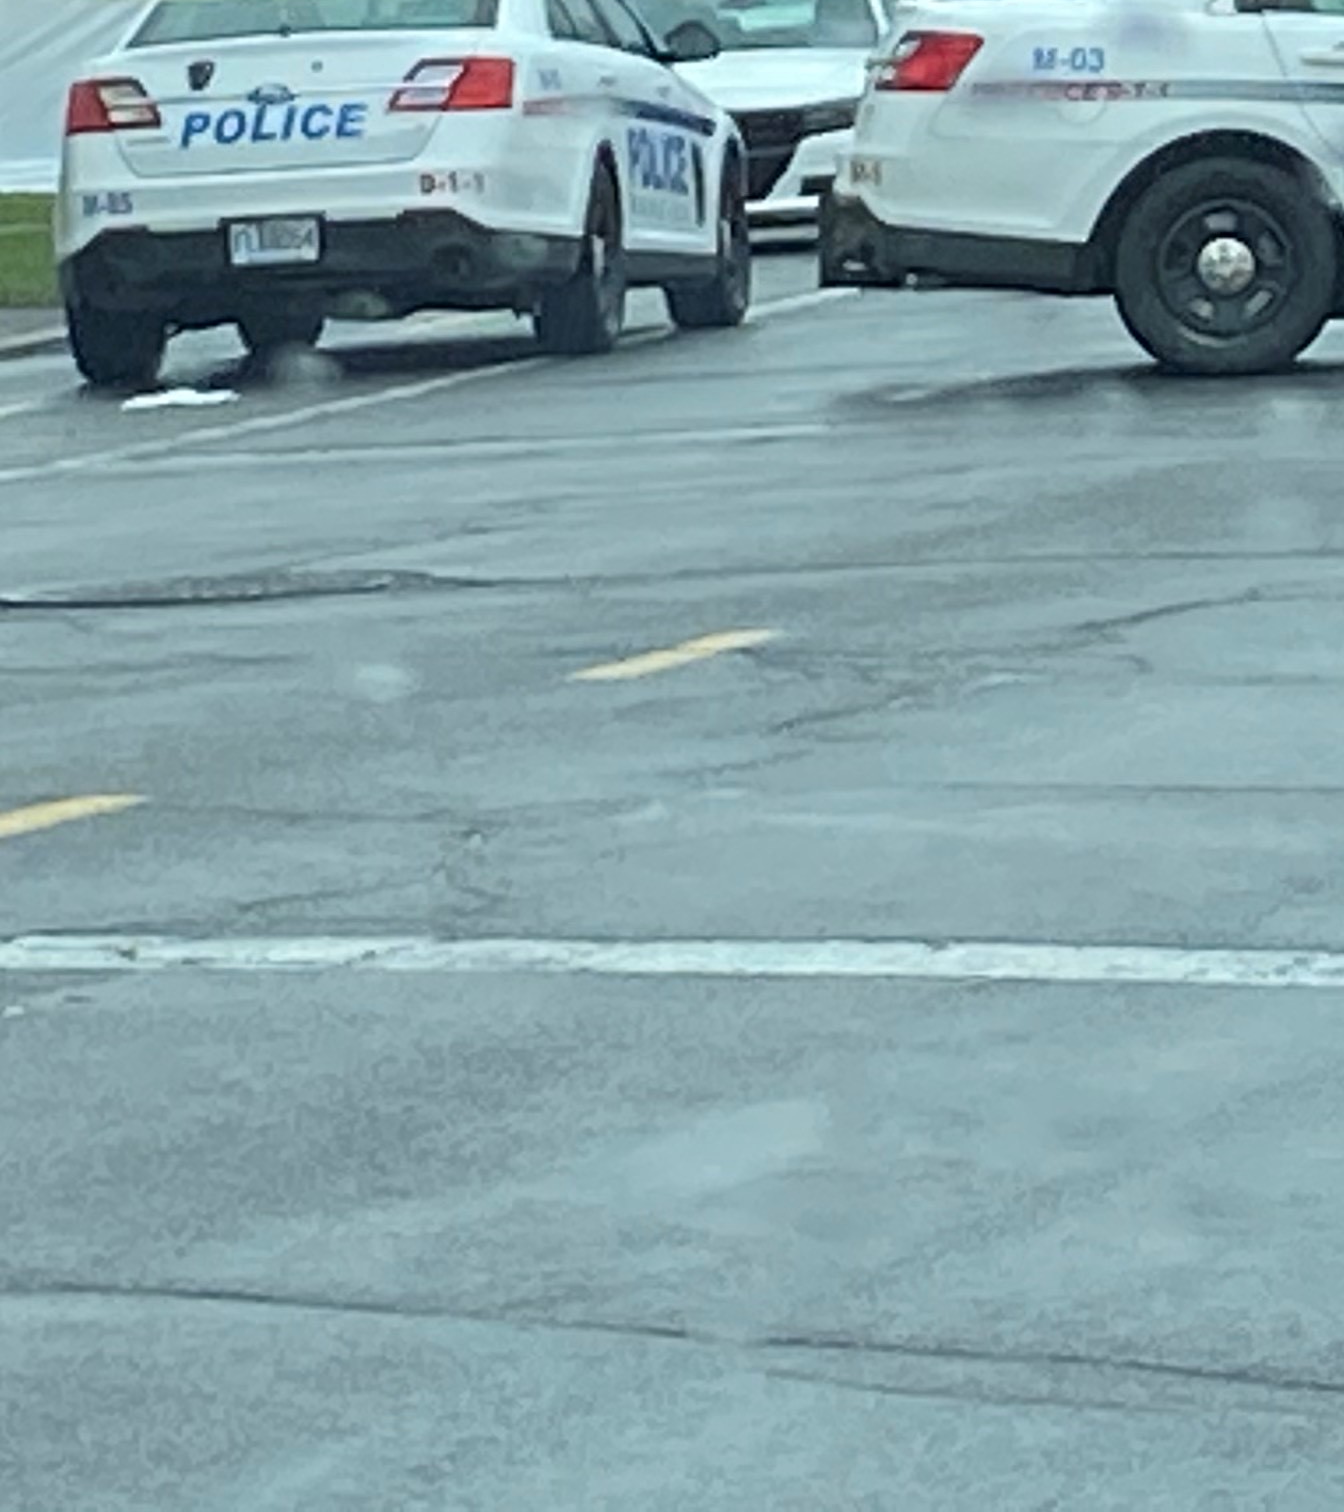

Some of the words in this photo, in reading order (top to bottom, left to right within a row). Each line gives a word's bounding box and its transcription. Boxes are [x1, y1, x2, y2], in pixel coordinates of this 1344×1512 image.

[1032, 47, 1105, 73] M-03
[179, 103, 369, 149] POLICE
[626, 125, 690, 197] POLICE
